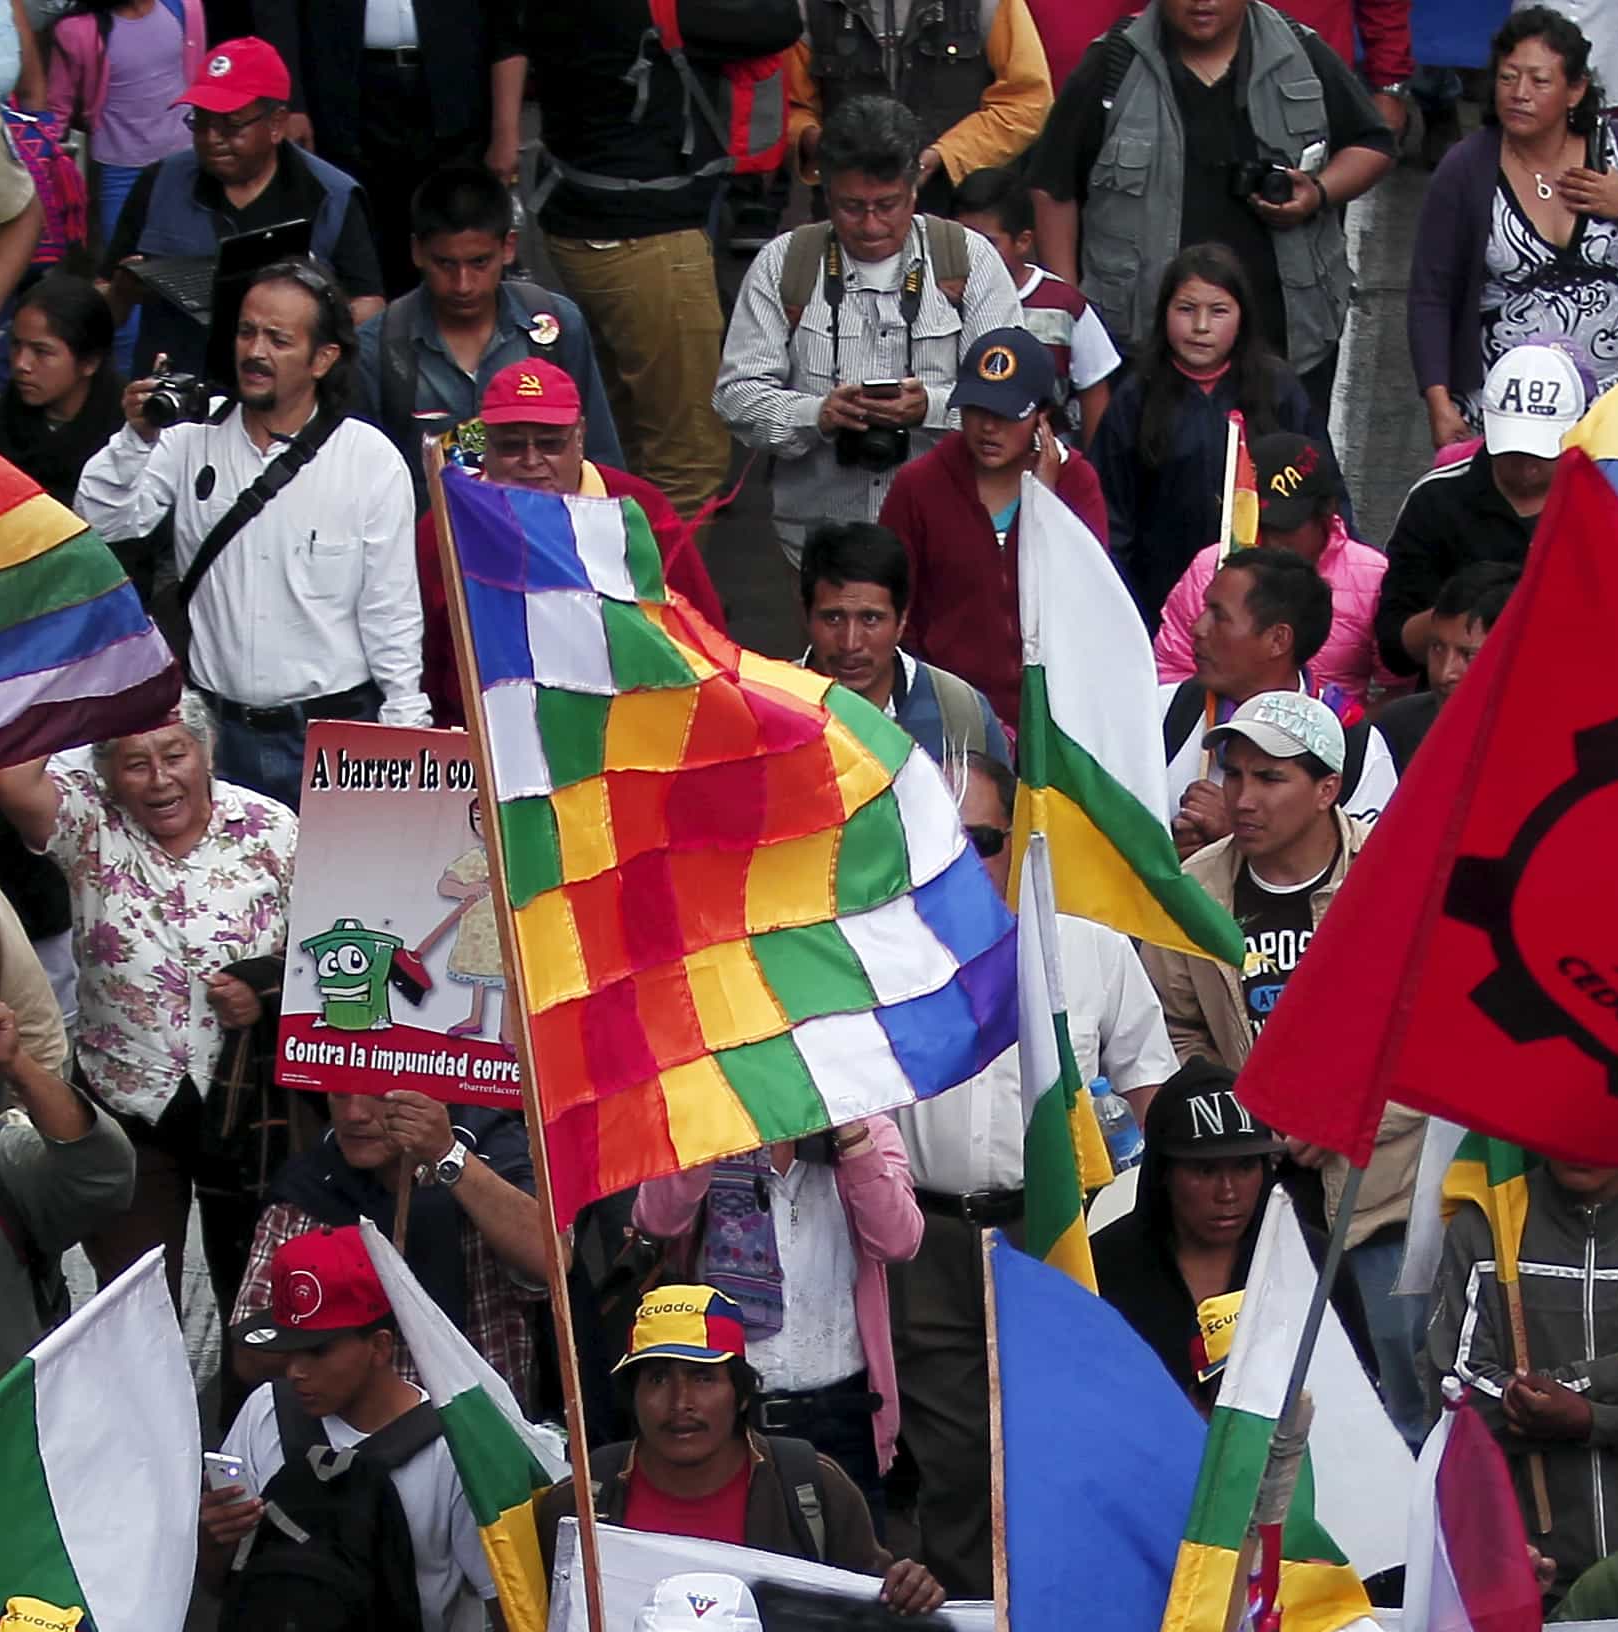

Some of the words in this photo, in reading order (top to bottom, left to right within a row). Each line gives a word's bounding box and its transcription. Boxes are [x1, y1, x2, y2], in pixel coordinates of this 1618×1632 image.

[310, 747, 332, 792] A
[336, 747, 415, 792] barrer
[418, 747, 441, 792] la
[284, 1036, 344, 1067] Contra
[349, 1042, 366, 1067] la
[370, 1045, 467, 1079] impunidad
